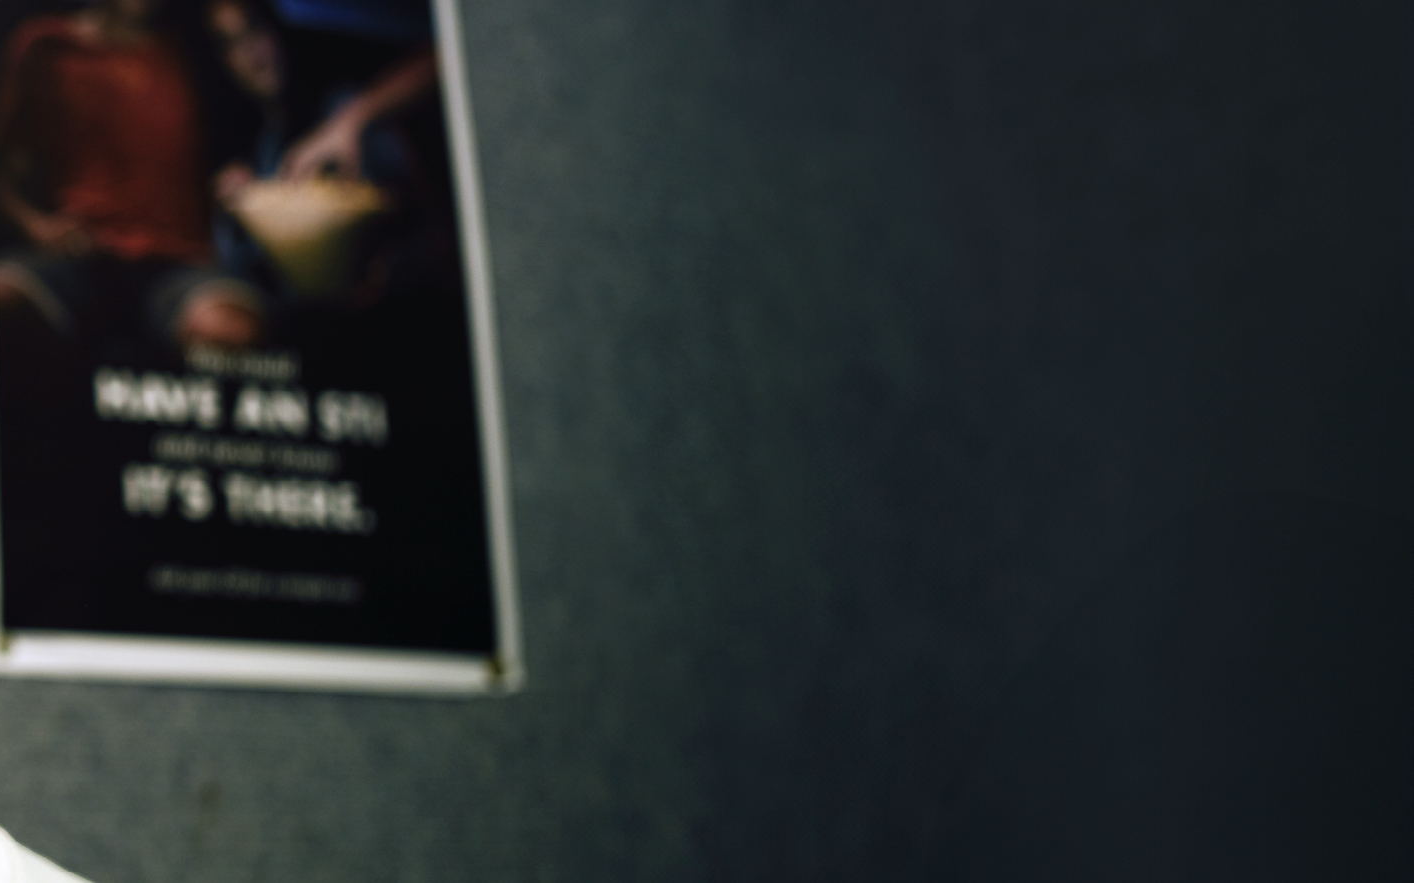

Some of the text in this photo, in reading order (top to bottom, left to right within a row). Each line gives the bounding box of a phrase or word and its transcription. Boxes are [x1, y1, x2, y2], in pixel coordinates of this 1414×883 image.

[94, 367, 222, 430] HAVE
[232, 383, 312, 435] AN
[121, 463, 215, 522] IT'S
